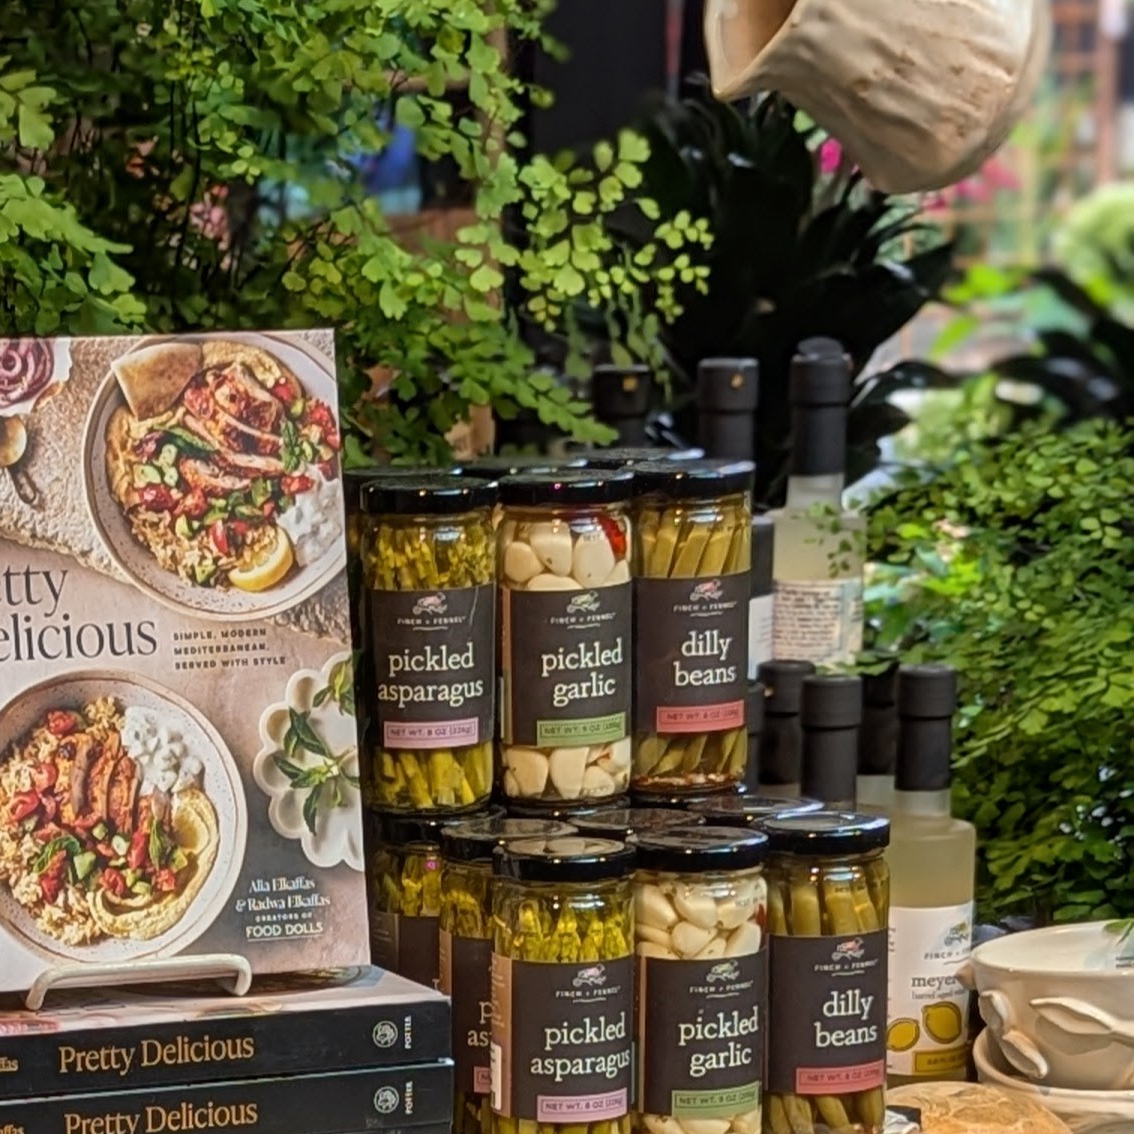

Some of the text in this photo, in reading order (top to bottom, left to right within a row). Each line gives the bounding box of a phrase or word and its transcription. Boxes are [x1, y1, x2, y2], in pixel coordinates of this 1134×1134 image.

[221, 629, 266, 638] MODERN
[681, 630, 732, 660] dilly
[175, 656, 286, 669] SERVED WITH STYLE
[389, 642, 474, 677] pickled
[542, 638, 623, 677] pickled
[673, 661, 737, 686] beans
[378, 679, 483, 708] asparagus
[553, 672, 616, 707] garlic
[246, 922, 323, 938] FOOD DOLLS
[924, 951, 952, 960] FINCH
[823, 989, 874, 1020] dilly
[545, 1012, 626, 1050] pickled
[679, 1006, 759, 1045] pickled
[814, 1022, 877, 1047] beans
[58, 1034, 255, 1076] Pretty Delicious
[531, 1049, 630, 1081] asparagus
[690, 1042, 752, 1076] garlic
[145, 1102, 259, 1134] Delicious
[592, 1101, 603, 1109] OZ
